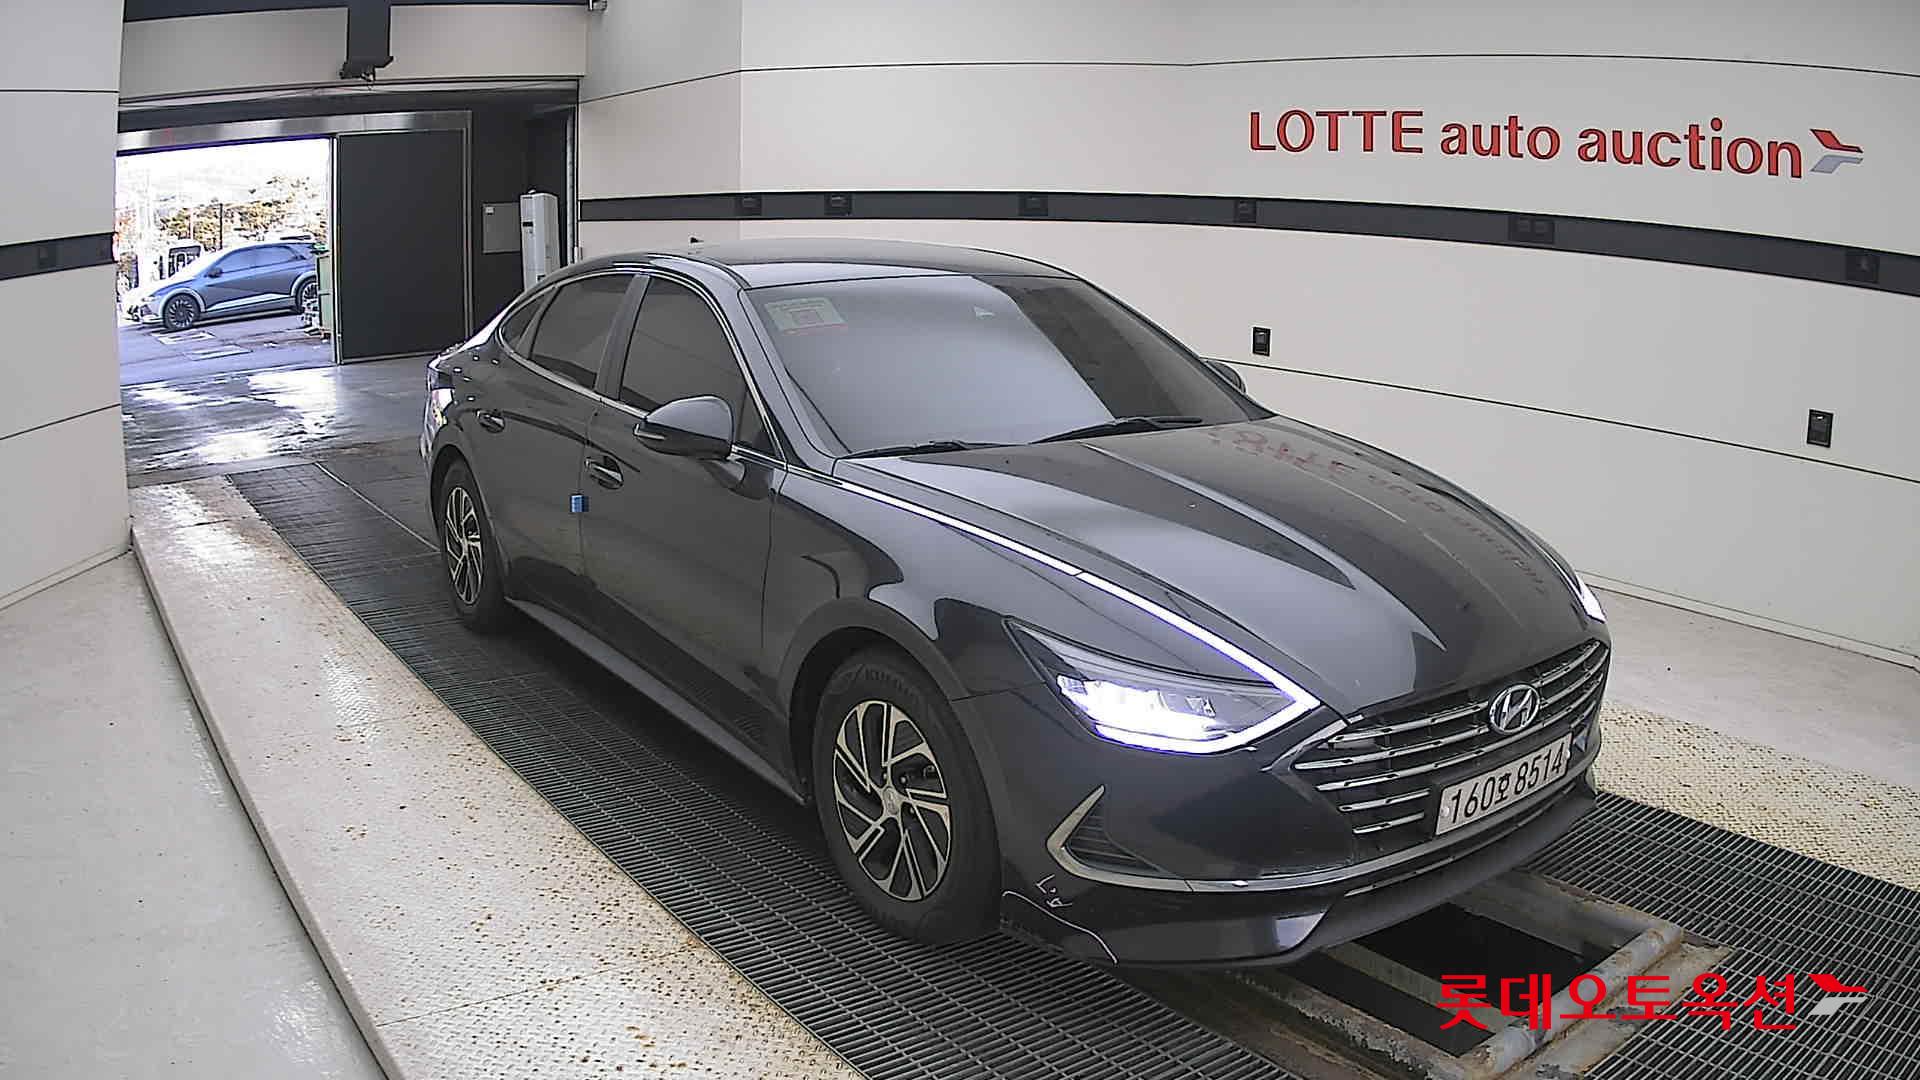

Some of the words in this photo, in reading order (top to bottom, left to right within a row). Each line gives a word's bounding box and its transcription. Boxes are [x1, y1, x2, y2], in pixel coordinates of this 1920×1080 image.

[1249, 109, 1425, 153] LOTTE
[1440, 115, 1561, 160] auto
[1577, 117, 1803, 179] auction
